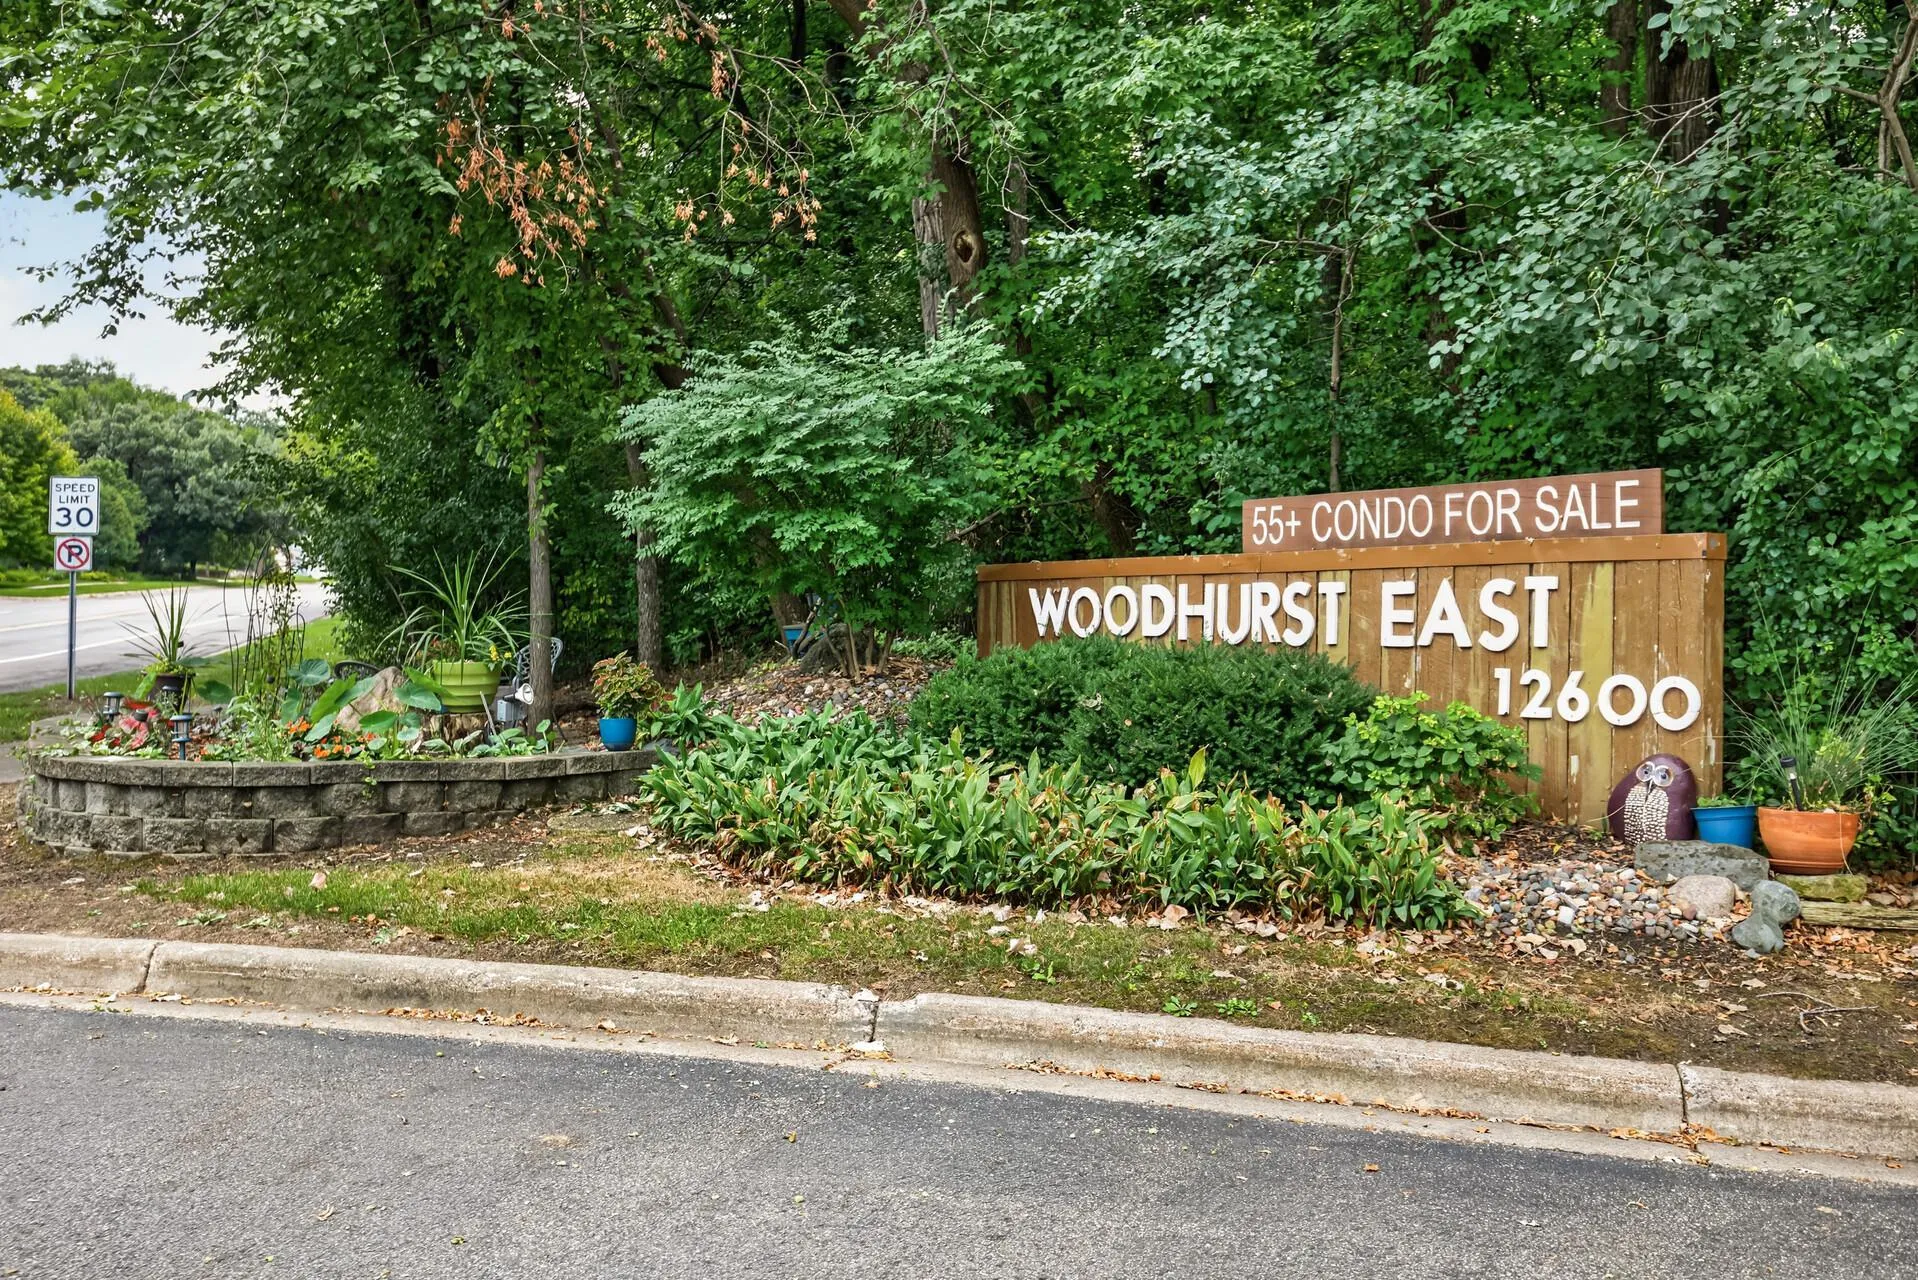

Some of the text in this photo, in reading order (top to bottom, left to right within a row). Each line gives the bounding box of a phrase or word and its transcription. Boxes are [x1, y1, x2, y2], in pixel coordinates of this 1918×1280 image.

[55, 483, 95, 493] SPEED
[59, 495, 90, 504] LIMIT
[55, 507, 93, 527] 30
[1251, 479, 1641, 546] 55+ CONDO FOR SALE
[1028, 575, 1559, 652] WOODHURST EAST
[1493, 667, 1702, 731] 12600
